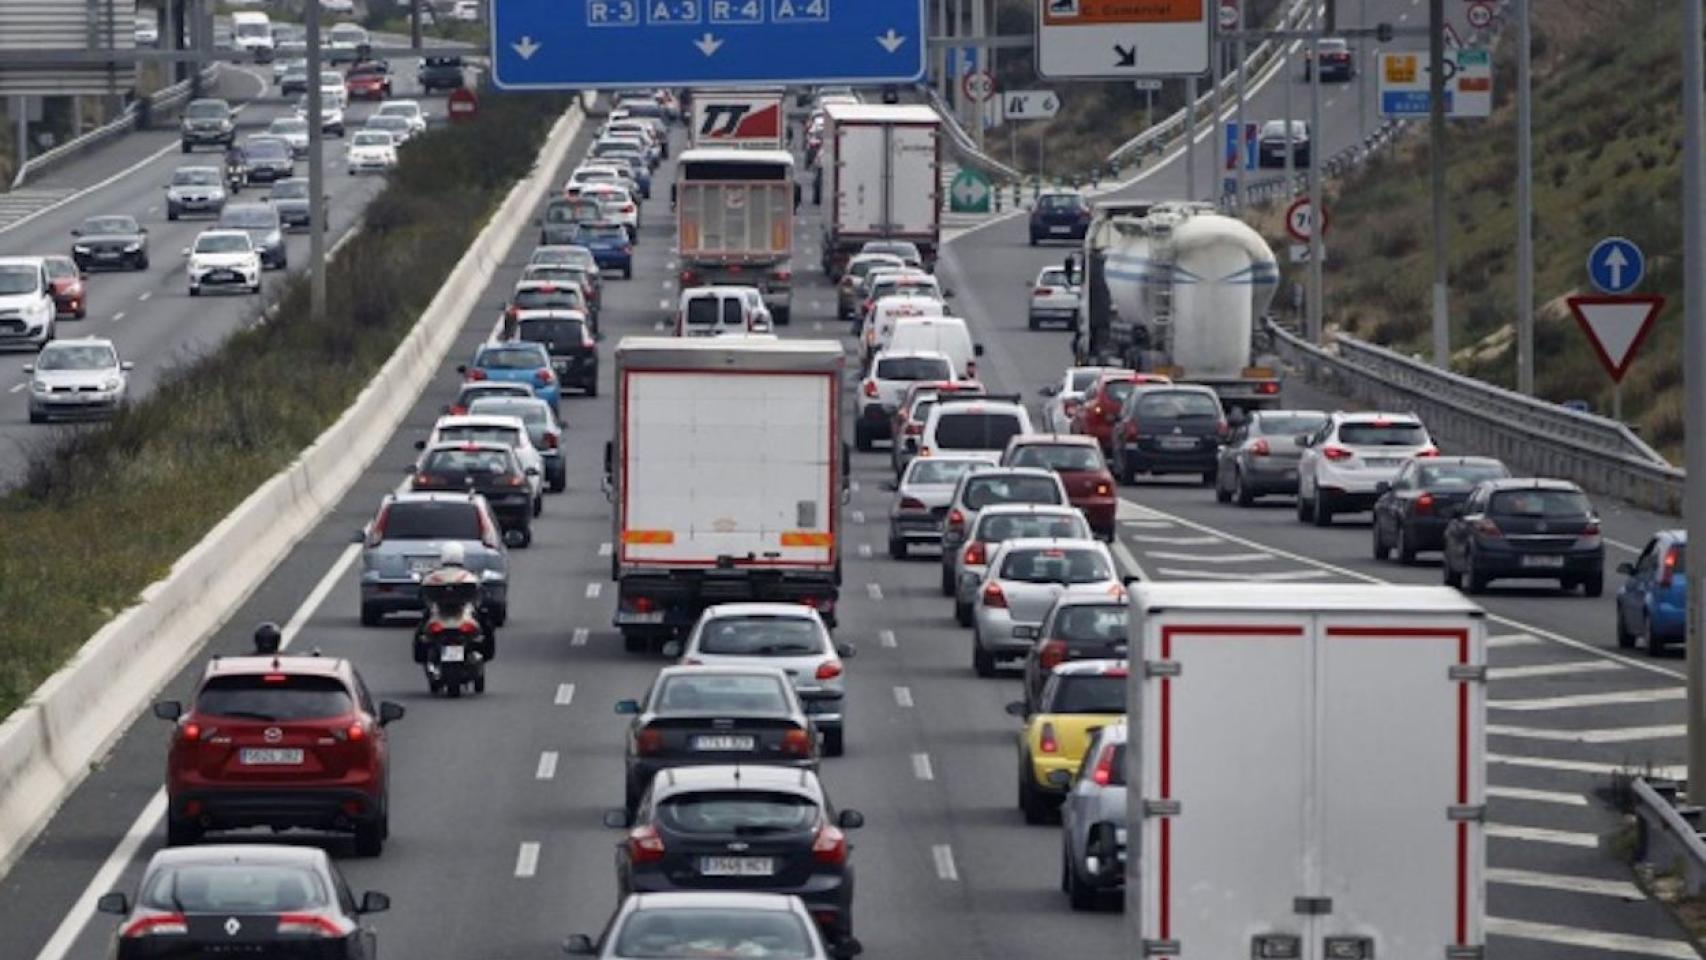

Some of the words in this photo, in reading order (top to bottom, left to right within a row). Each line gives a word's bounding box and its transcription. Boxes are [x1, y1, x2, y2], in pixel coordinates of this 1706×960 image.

[591, 1, 634, 21] R-3
[653, 0, 697, 19] A-3
[712, 0, 759, 18] R-4
[778, 0, 825, 17] A-4
